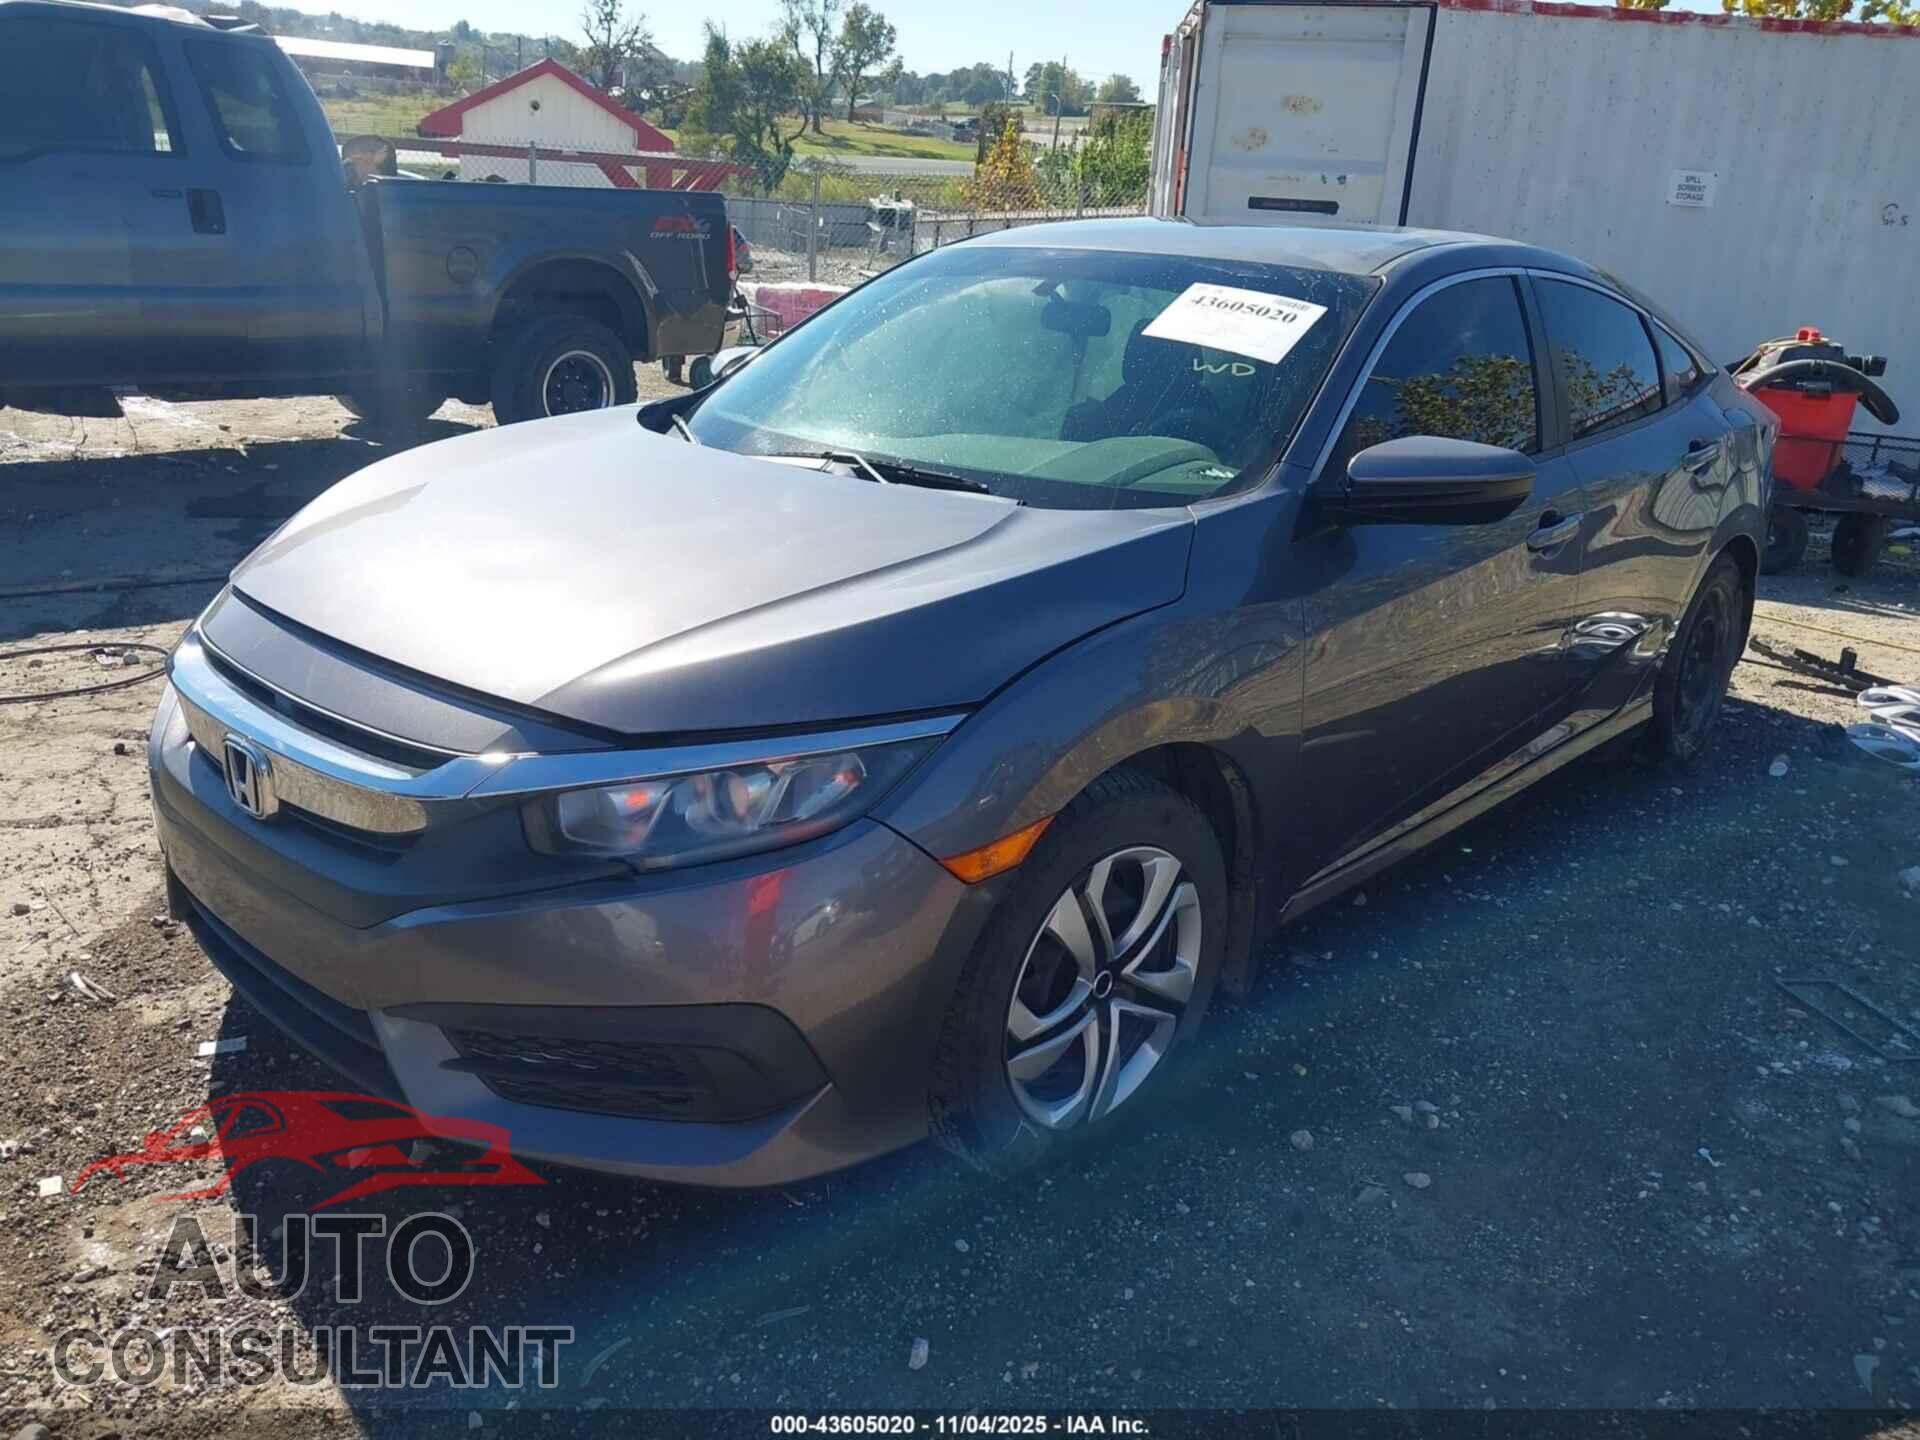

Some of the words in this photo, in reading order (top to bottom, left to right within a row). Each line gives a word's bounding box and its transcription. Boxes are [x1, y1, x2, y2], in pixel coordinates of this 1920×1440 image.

[649, 231, 674, 240] OFF
[676, 231, 712, 240] ROAD
[1191, 295, 1298, 324] 43605020
[1193, 358, 1256, 376] WD
